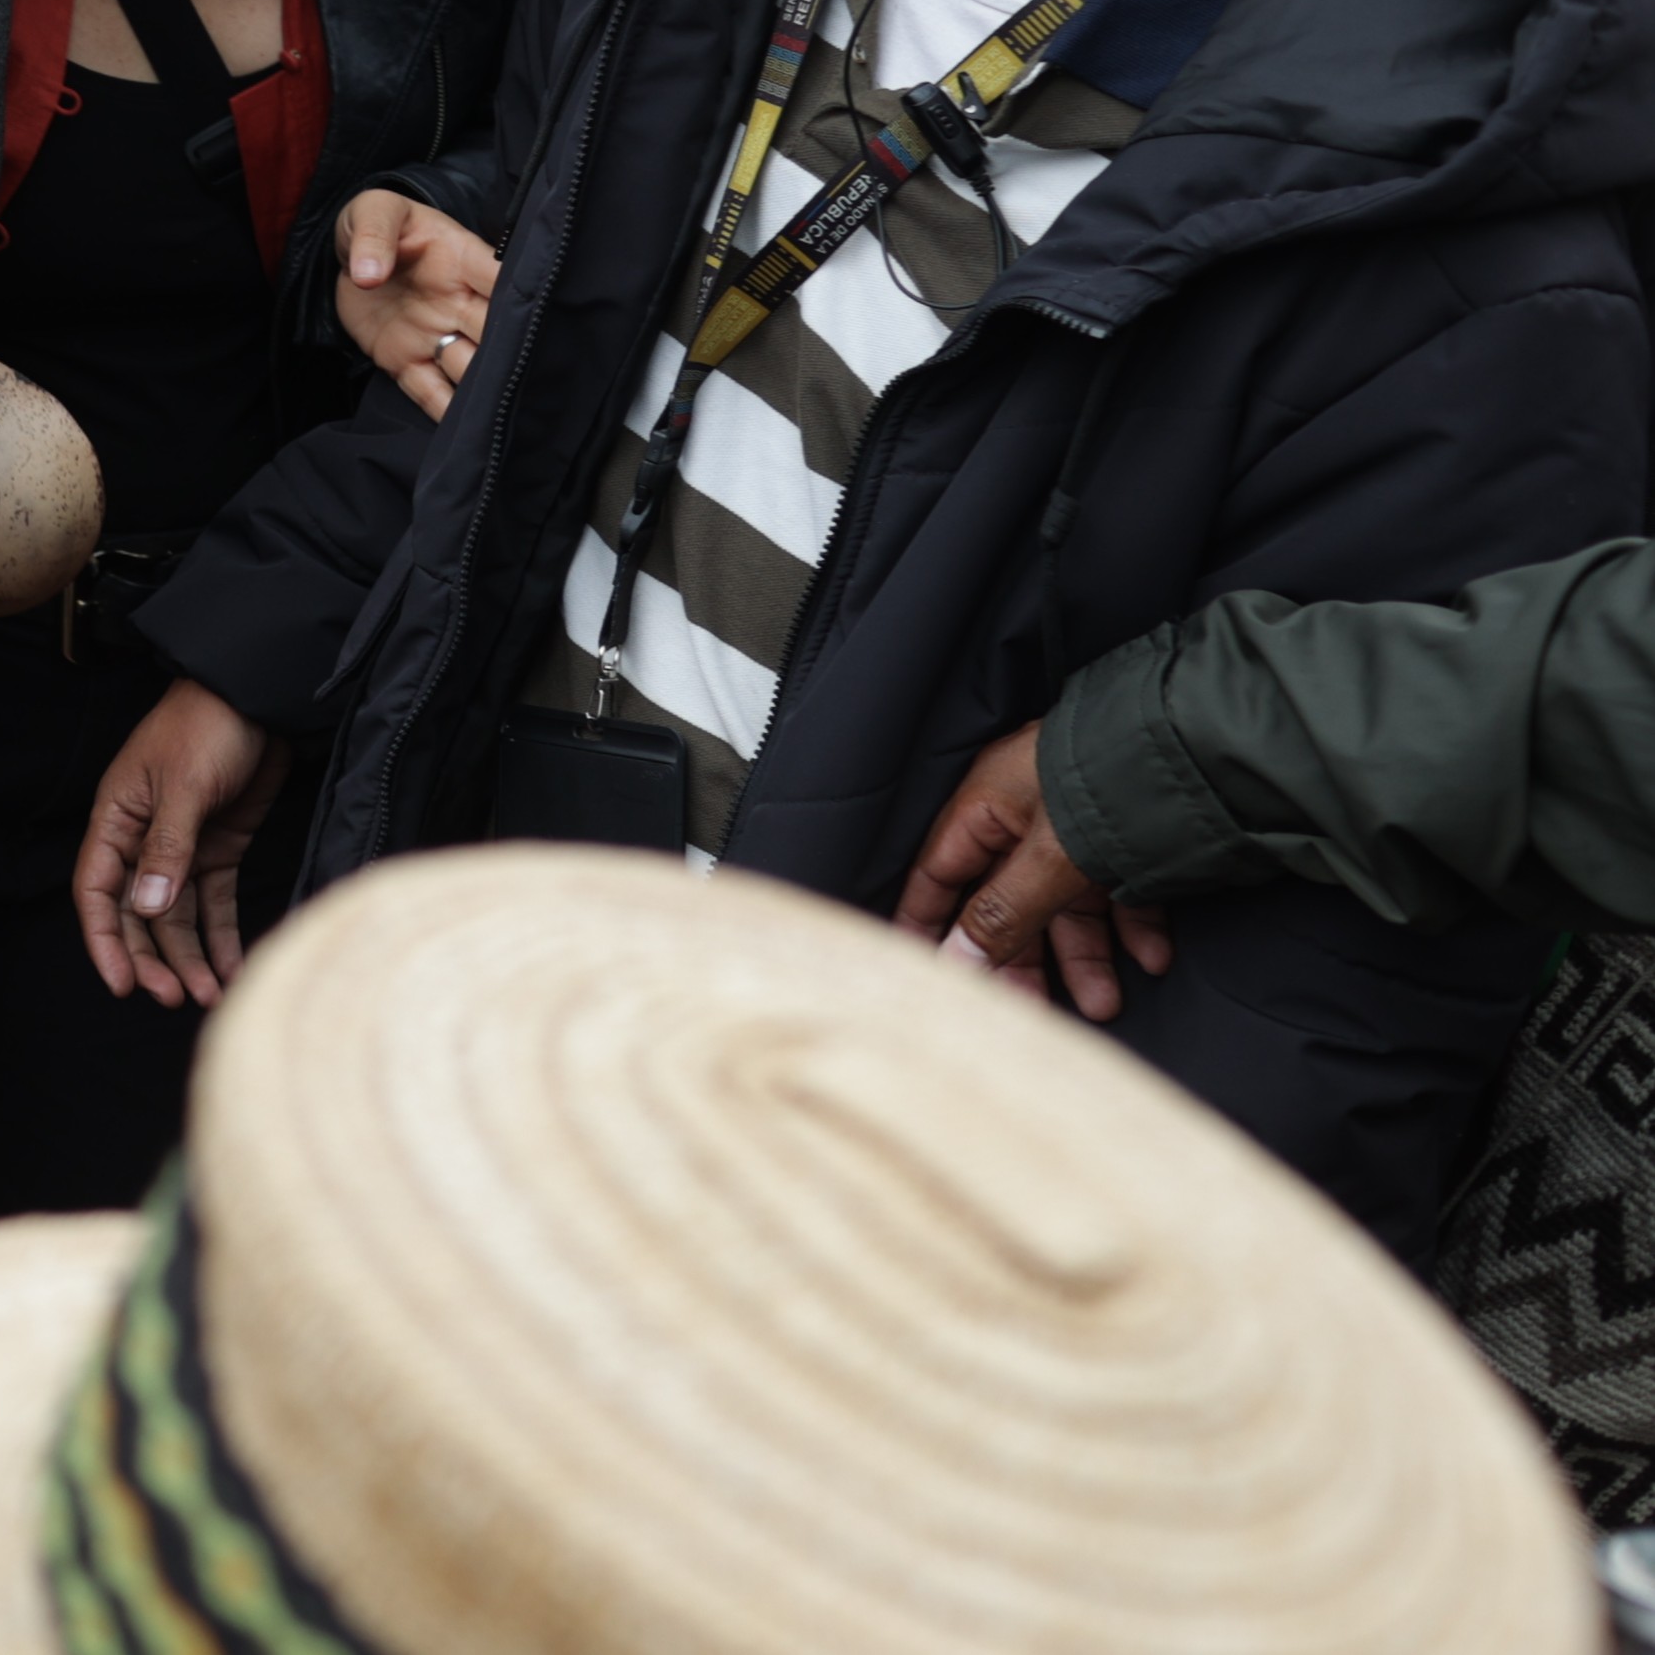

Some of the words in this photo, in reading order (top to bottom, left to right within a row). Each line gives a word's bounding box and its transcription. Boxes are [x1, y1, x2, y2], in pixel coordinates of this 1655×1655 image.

[845, 183, 889, 226] SNADO
[829, 224, 849, 242] DE
[815, 239, 833, 254] LA
